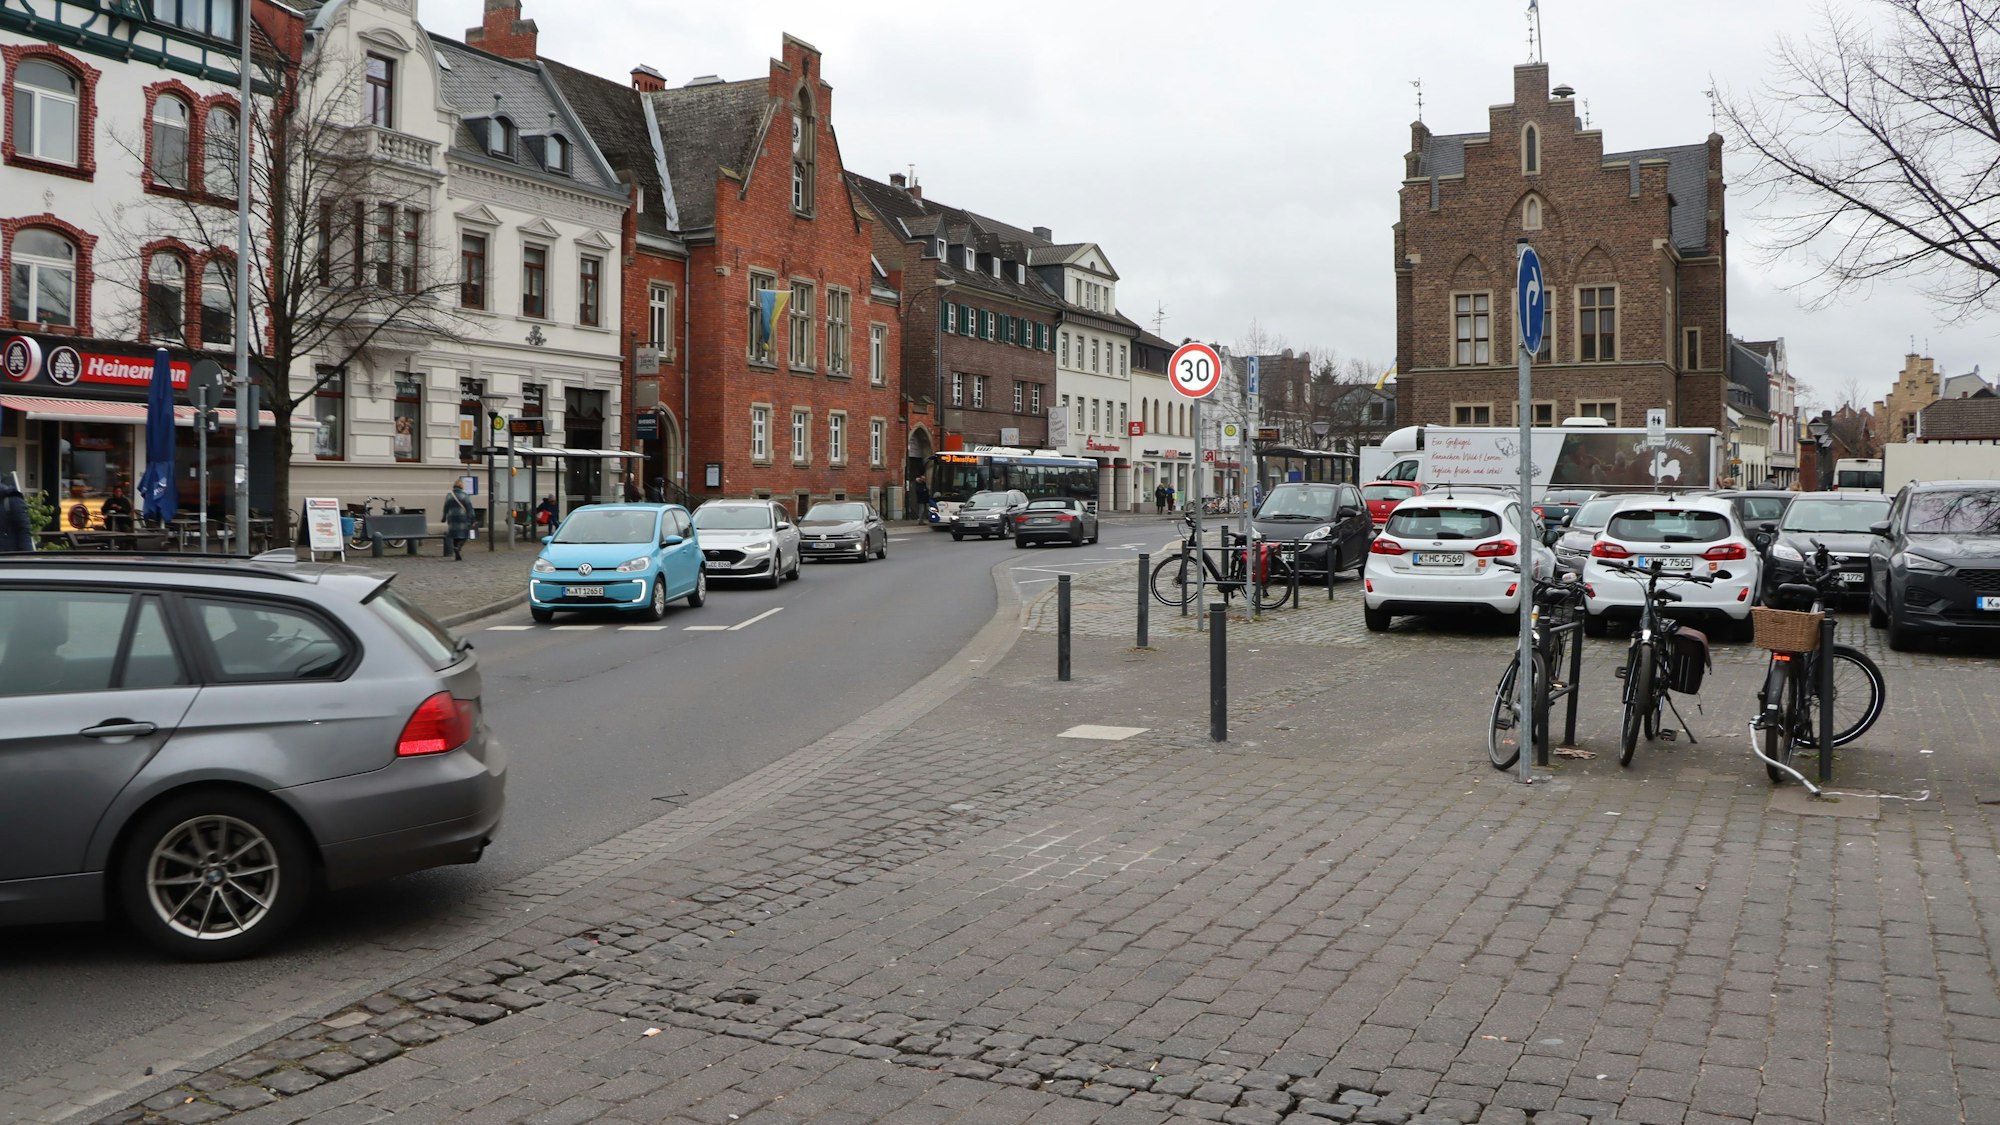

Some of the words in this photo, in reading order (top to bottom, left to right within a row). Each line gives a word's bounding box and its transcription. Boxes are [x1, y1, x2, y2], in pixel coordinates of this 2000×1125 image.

[87, 357, 187, 383] Heinemnn
[1180, 359, 1209, 382] 30
[1419, 555, 1425, 563] K
[1430, 555, 1439, 563] HC
[1442, 554, 1462, 563] 7569
[1645, 558, 1650, 566] K
[1669, 558, 1691, 567] 7565
[1847, 573, 1863, 581] 1775
[1987, 598, 1994, 607] K
